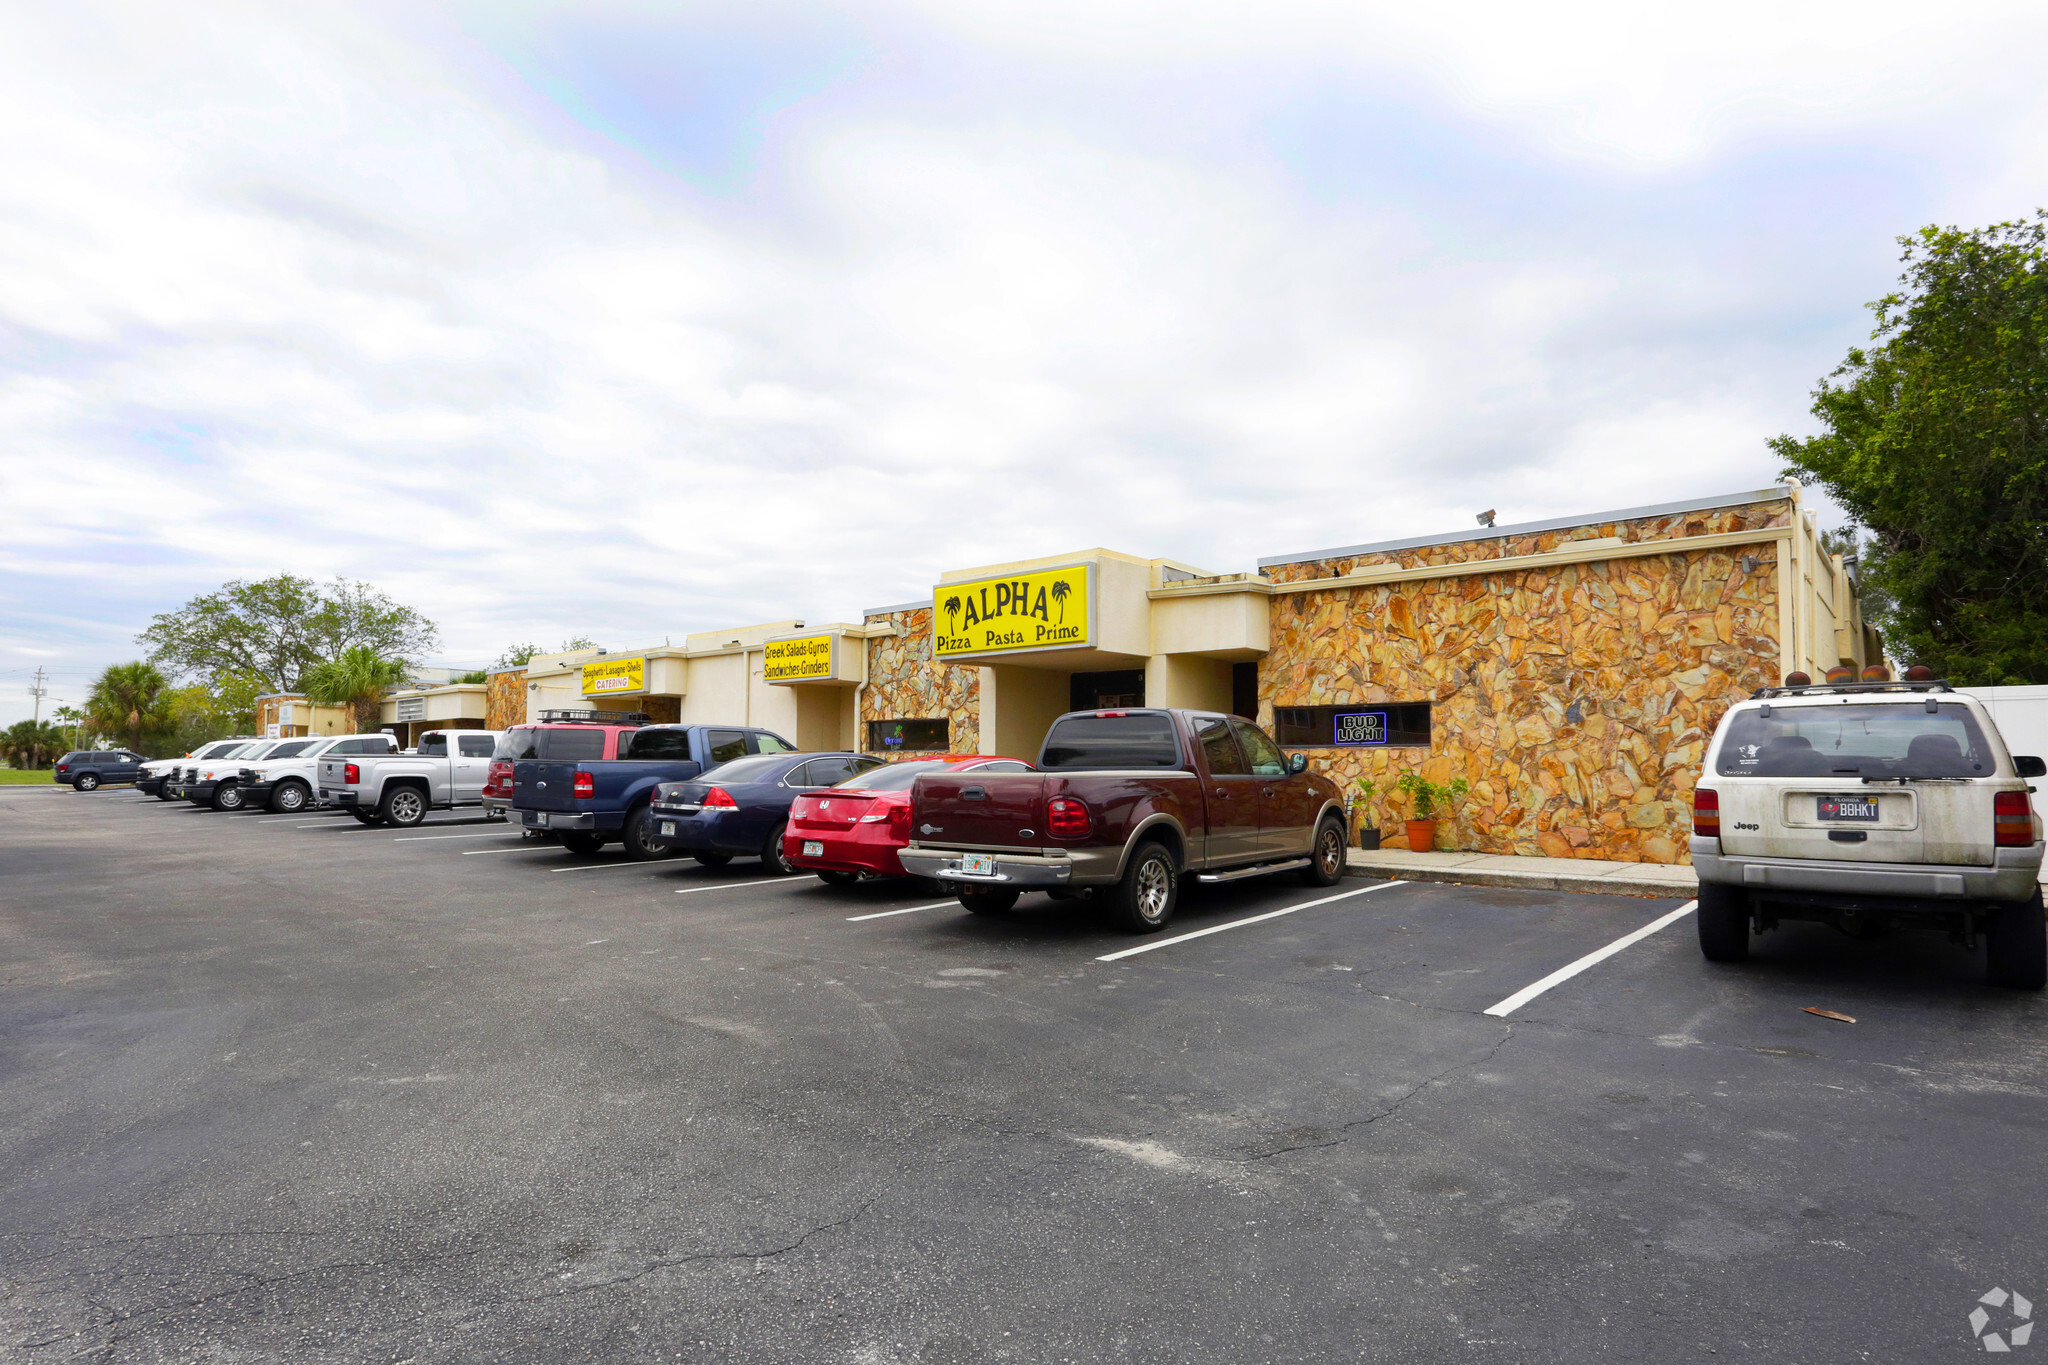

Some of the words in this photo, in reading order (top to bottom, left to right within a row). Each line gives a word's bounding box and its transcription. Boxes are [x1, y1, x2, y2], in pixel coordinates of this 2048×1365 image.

[963, 582, 1048, 631] ALPHA
[937, 636, 971, 650] Pizza
[986, 630, 1024, 645] Pasta
[1036, 624, 1079, 641] Prime
[765, 645, 785, 659] Greek
[596, 677, 627, 689] CATERING
[1344, 715, 1377, 728] BUD
[1338, 728, 1383, 741] LIGHT
[1734, 822, 1759, 831] Jeep
